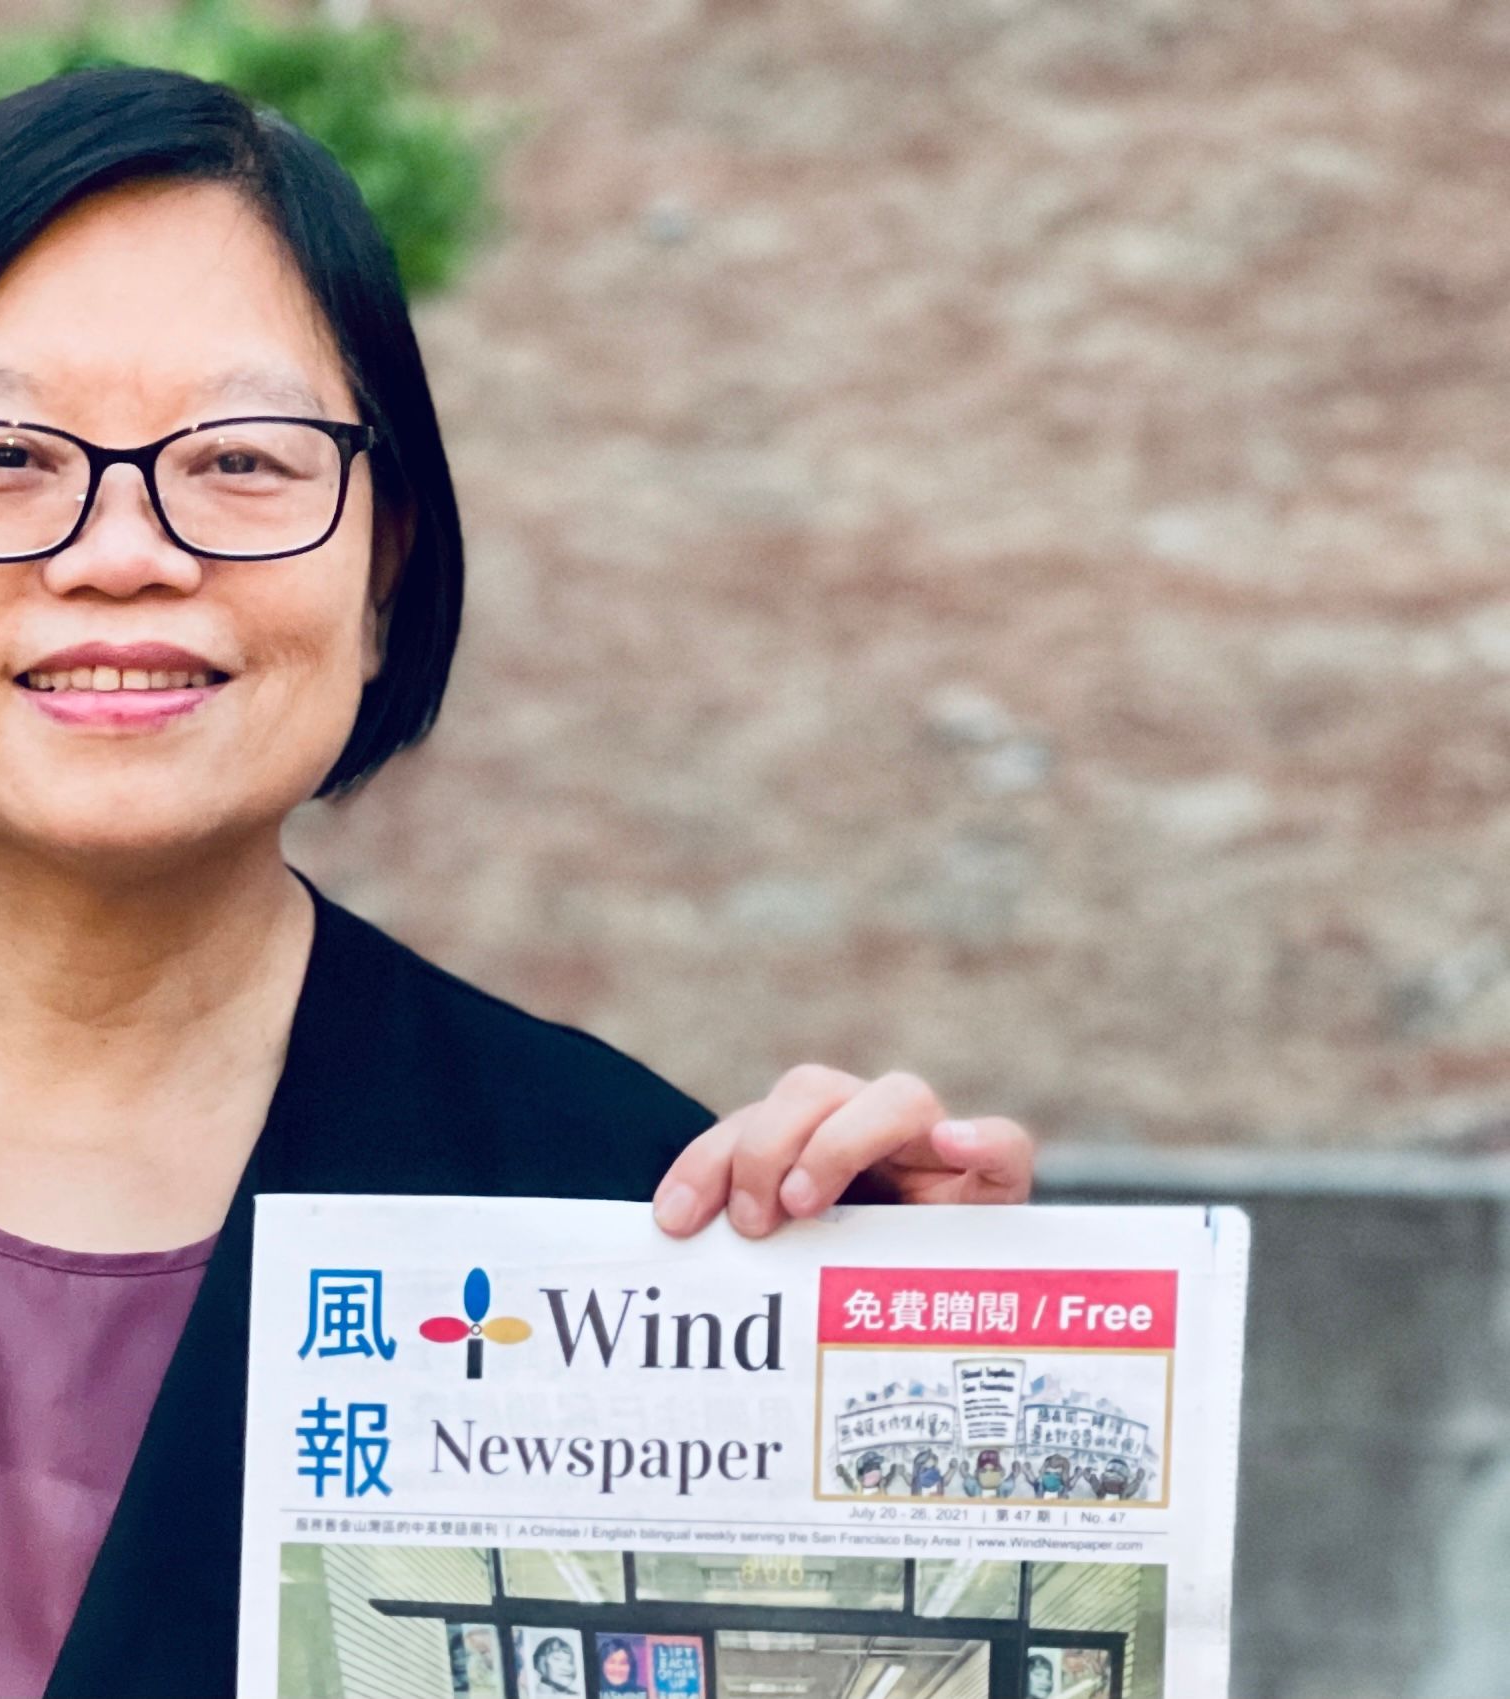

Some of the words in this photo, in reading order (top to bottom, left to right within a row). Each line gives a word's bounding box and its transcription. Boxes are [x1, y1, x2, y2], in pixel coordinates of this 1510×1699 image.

[539, 1285, 787, 1372] Wind
[842, 1289, 1019, 1334] 免費贈閱
[1058, 1297, 1152, 1332] Free
[429, 1418, 784, 1497] Newspaper
[530, 1525, 581, 1538] Chinese
[592, 1527, 637, 1542] English
[640, 1528, 691, 1542] bilingual
[694, 1530, 737, 1543] weekly
[740, 1532, 785, 1545] serving
[788, 1531, 808, 1543] the
[811, 1532, 837, 1544] San
[840, 1532, 902, 1546] Francisco
[904, 1534, 929, 1550] Bay
[931, 1535, 961, 1547] Area
[848, 1506, 876, 1522] July
[879, 1507, 897, 1520] 20
[936, 1508, 969, 1521] 2021
[1014, 1509, 1032, 1522] 47
[1108, 1511, 1127, 1524] 47
